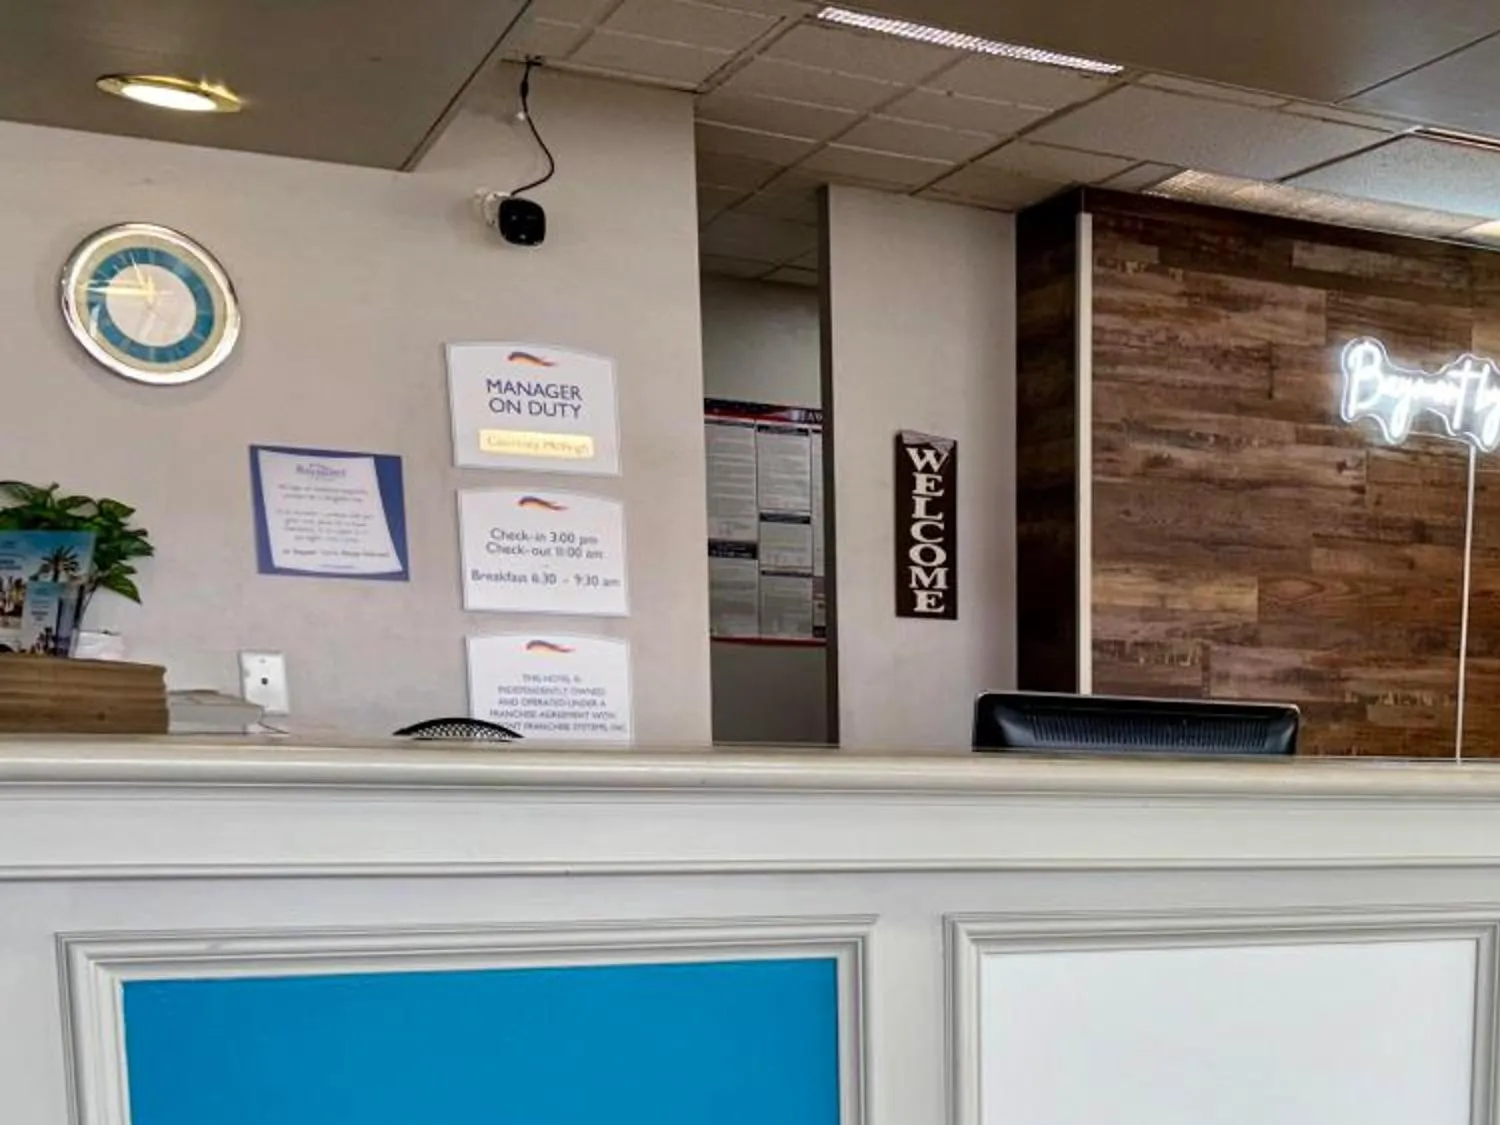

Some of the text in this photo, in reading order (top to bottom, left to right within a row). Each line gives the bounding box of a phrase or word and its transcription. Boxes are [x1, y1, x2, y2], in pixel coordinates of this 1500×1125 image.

[486, 378, 583, 401] MANAGER
[488, 397, 582, 420] ON DUTY
[489, 527, 599, 546] Check-in 3:00 pm
[906, 447, 949, 614] WELCOME
[485, 541, 604, 559] Check-out 11:00 am
[471, 568, 528, 583] Breakfast
[602, 577, 621, 587] am
[497, 697, 519, 707] AND
[521, 698, 567, 708] OPERATED
[568, 699, 598, 708] UNDER
[489, 709, 537, 720] FRANCHISE
